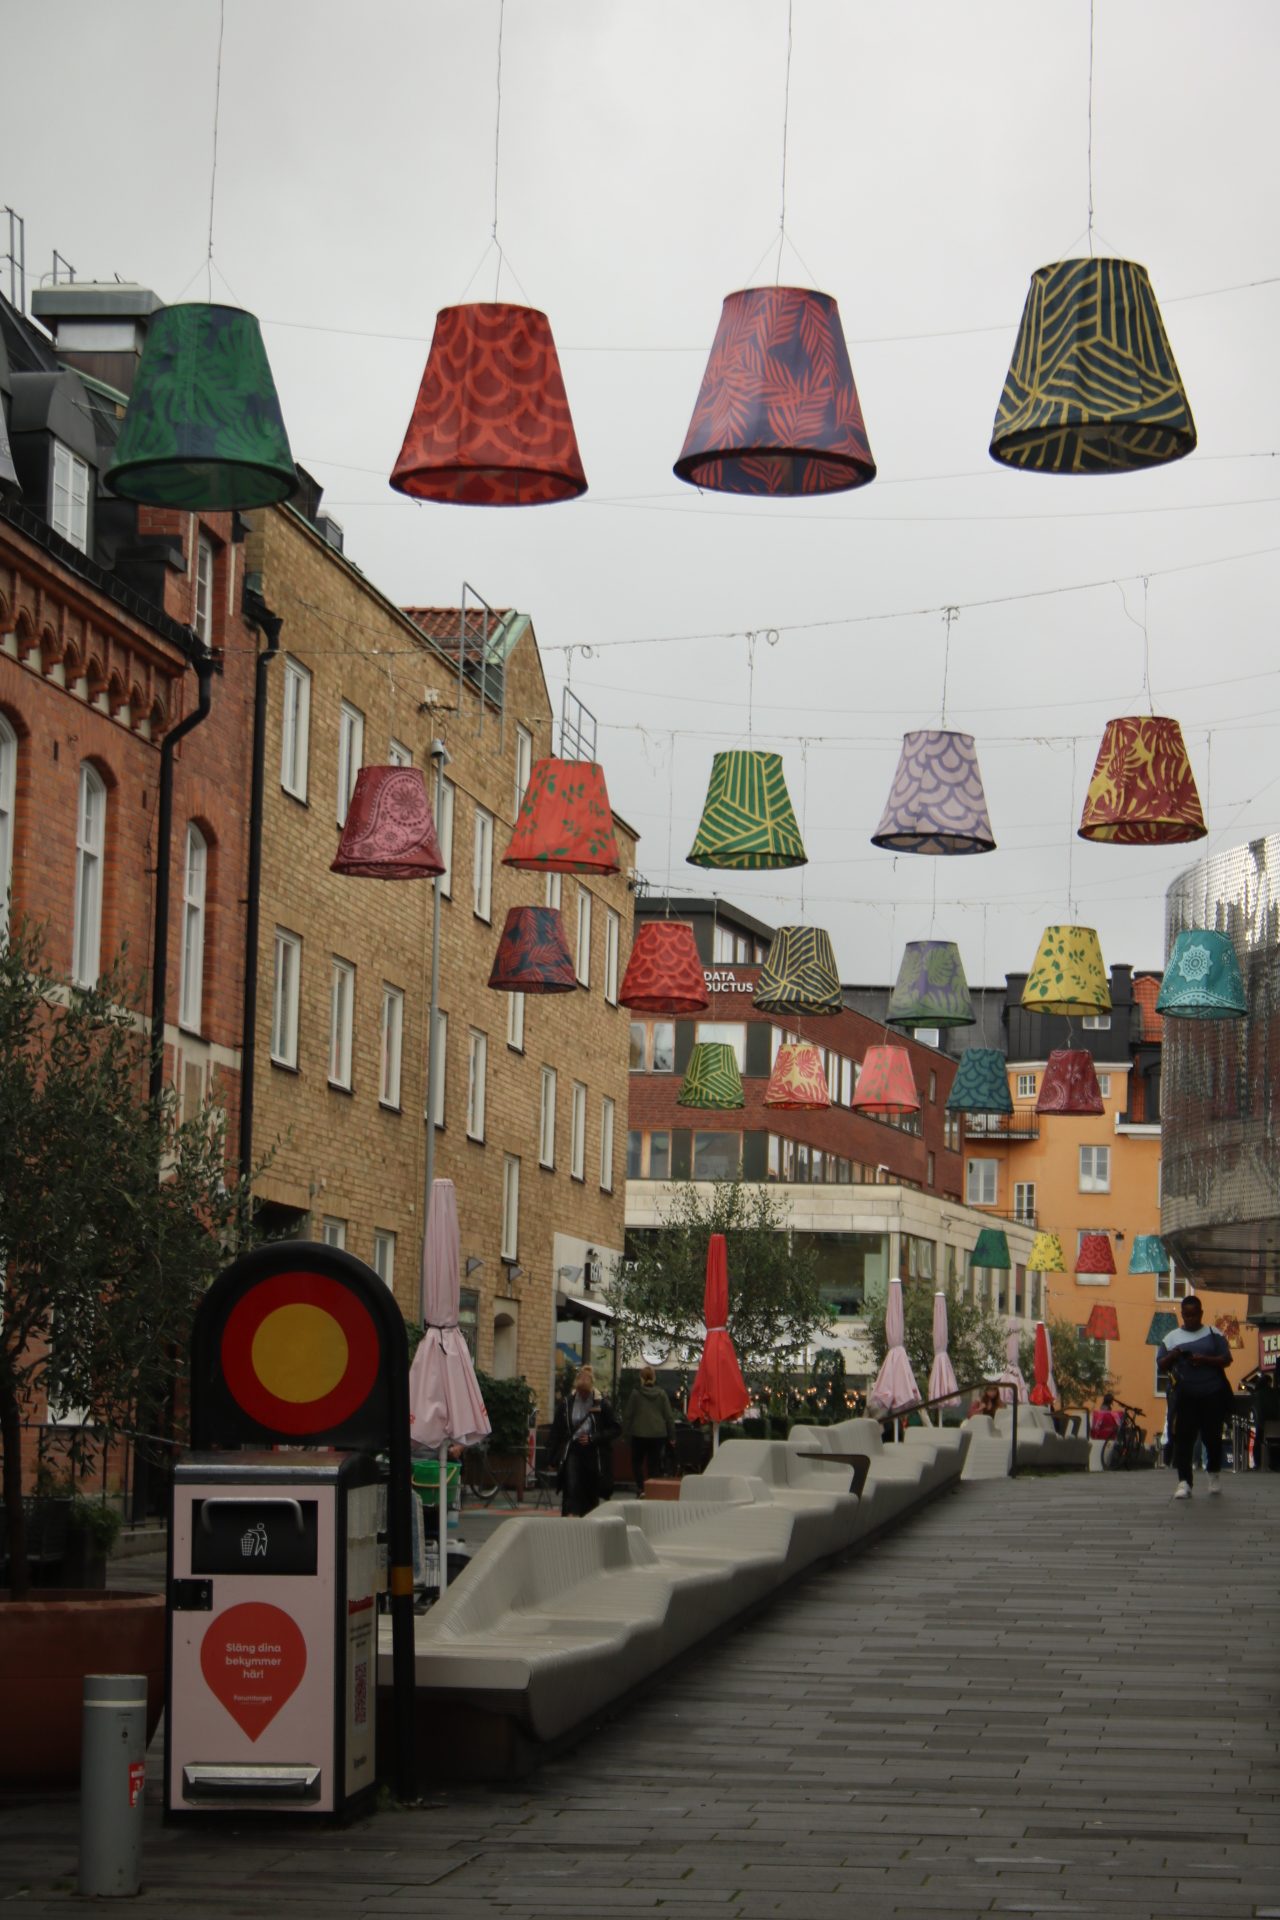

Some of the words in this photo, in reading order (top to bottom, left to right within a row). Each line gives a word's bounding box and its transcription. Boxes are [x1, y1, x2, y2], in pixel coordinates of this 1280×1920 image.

[703, 971, 735, 981] DATA
[225, 1643, 256, 1654] Släng
[258, 1643, 281, 1653] dina
[225, 1656, 282, 1668] bekymmer
[243, 1669, 264, 1679] här!
